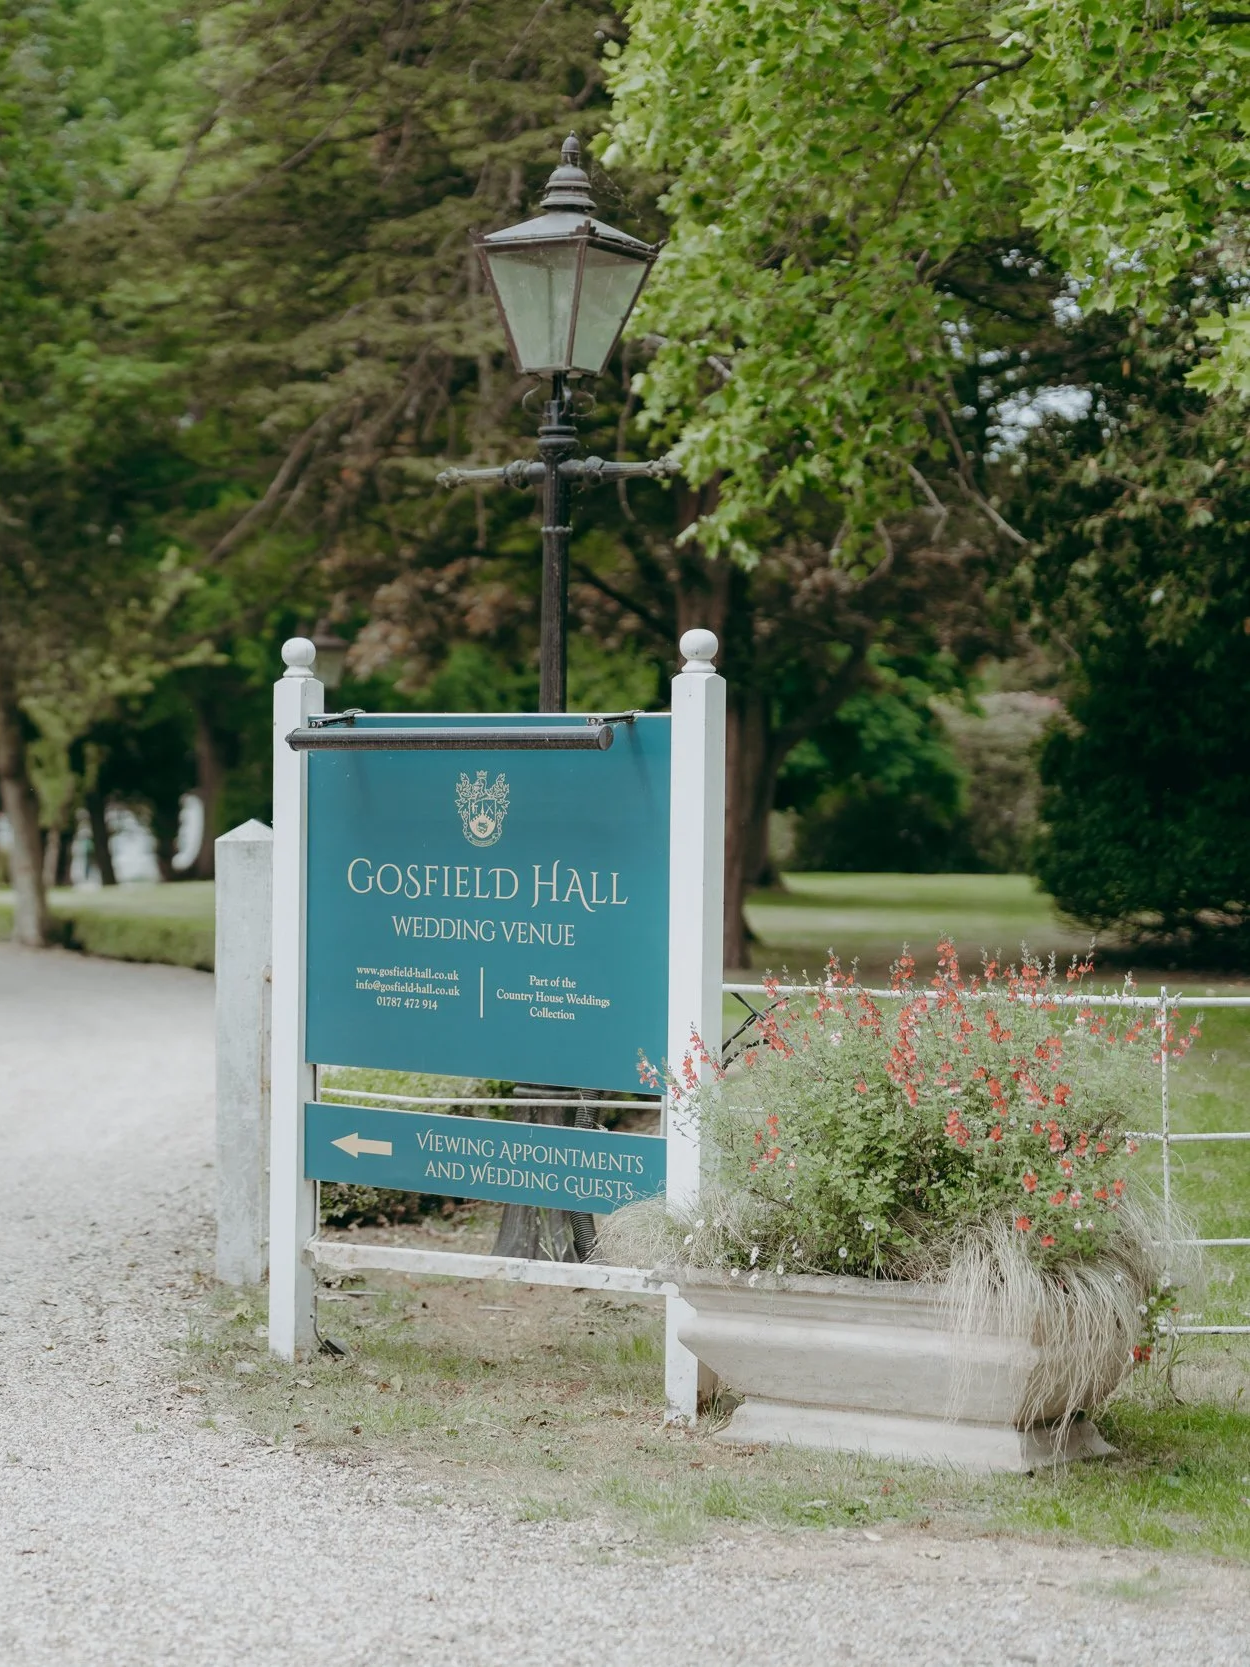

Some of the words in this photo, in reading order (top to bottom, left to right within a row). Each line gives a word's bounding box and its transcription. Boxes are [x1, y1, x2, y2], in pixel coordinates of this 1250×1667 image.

[347, 857, 519, 900] GOSFIELD
[531, 859, 629, 913] HALL
[391, 915, 496, 942] WEDDING
[500, 921, 576, 946] VENUE
[356, 965, 459, 981] www.gosfield-hall.co.uk
[529, 975, 548, 987] Part
[550, 976, 560, 987] of
[562, 977, 576, 988] the
[355, 979, 460, 996] info@gosfield-hall.co.uk
[376, 996, 402, 1008] 01787
[404, 998, 420, 1009] 472
[422, 999, 438, 1010] 914
[496, 988, 534, 1003] Country
[535, 991, 564, 1003] House
[566, 993, 610, 1008] Weddings
[529, 1006, 575, 1020] Collection
[415, 1128, 495, 1158] VIEWING
[500, 1140, 645, 1175] APPOINTMENTS
[424, 1160, 465, 1181] AND
[469, 1161, 559, 1192] WEDDING
[564, 1175, 634, 1201] GUESTS
